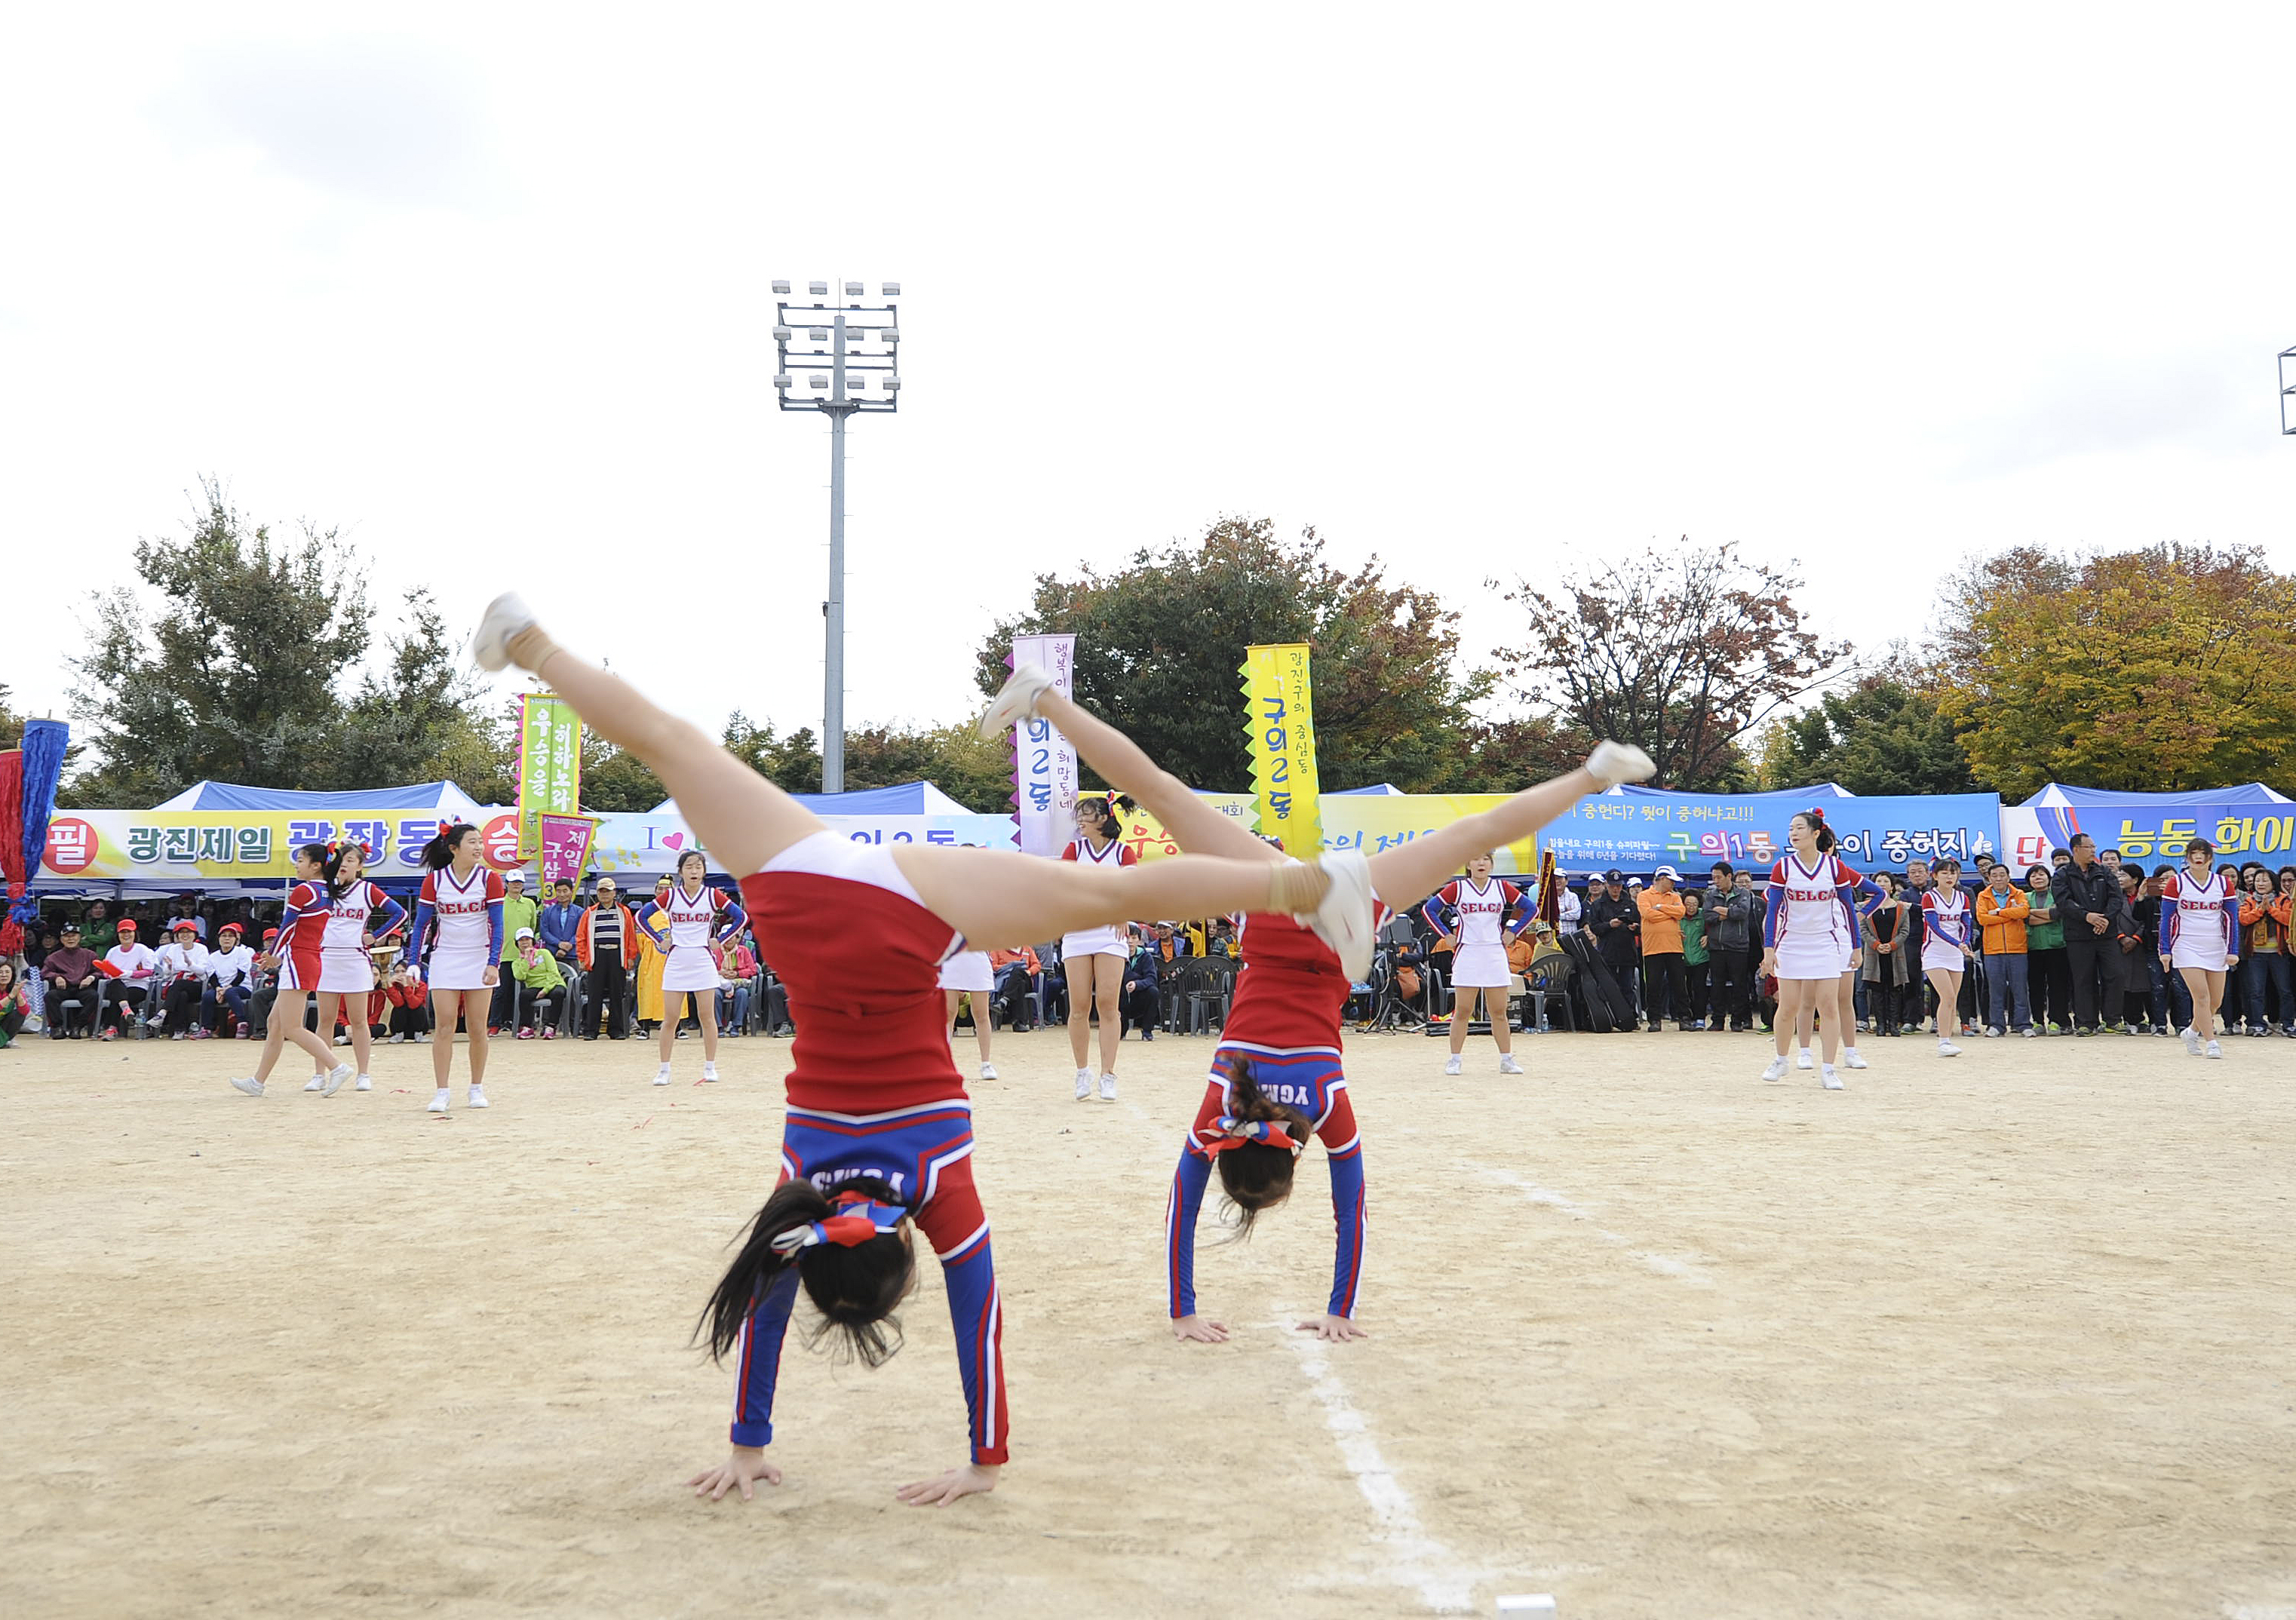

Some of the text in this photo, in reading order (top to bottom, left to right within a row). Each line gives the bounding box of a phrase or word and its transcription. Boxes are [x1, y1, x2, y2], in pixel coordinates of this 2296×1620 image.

[1289, 652, 1308, 775] 광진구의 중심동
[527, 708, 552, 798] 우승을
[1027, 718, 1051, 812] 의2동
[1262, 697, 1292, 820] 구의2동
[1057, 749, 1073, 810] 희망동네
[1641, 804, 1671, 821] 뭣이
[48, 824, 87, 866] 필
[127, 826, 272, 864] 광진제일
[641, 827, 661, 850] I
[1665, 830, 1780, 865] 구의1동
[1880, 828, 1968, 862] 중허지
[2116, 818, 2197, 858] 능동
[2214, 815, 2295, 854] 화이
[671, 913, 710, 922] SELCA
[1461, 902, 1501, 913] SELCA
[1939, 913, 1960, 922] ELC
